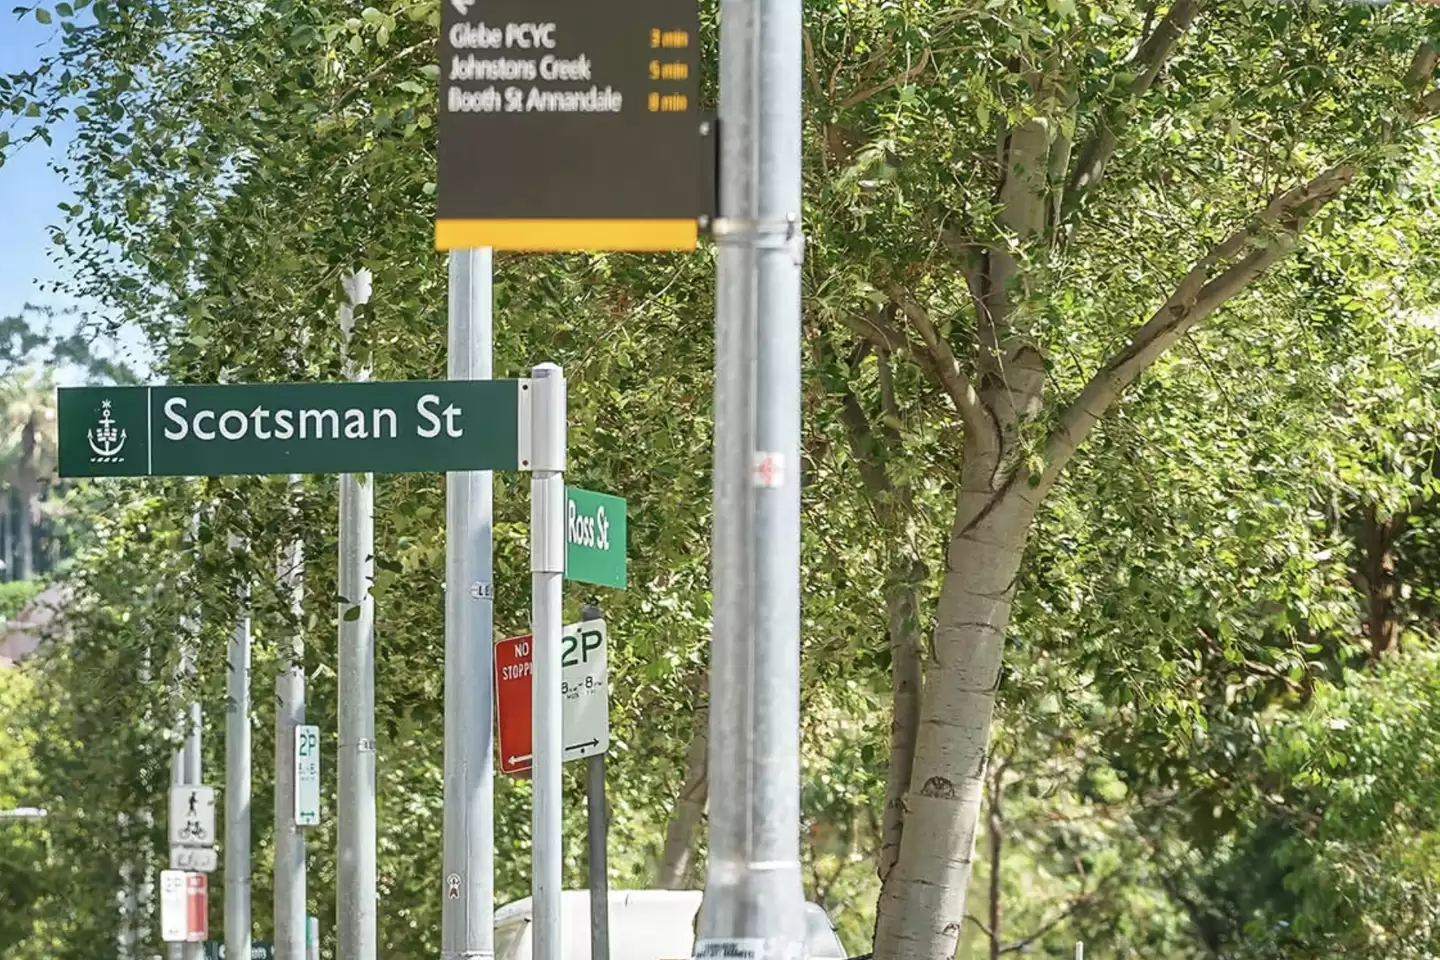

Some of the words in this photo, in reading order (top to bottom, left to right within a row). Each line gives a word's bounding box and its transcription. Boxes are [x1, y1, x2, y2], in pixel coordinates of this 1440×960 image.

[449, 22, 503, 49] Glebe
[505, 22, 557, 49] PCYC
[650, 28, 661, 48] 3
[661, 31, 689, 48] min
[449, 53, 537, 80] Johnstons
[539, 53, 592, 80] Creek
[661, 61, 689, 80] min
[448, 86, 502, 112] Booth
[504, 86, 523, 112] St
[526, 85, 623, 112] Annandale
[661, 93, 688, 112] min
[163, 396, 398, 440] Scotsman
[416, 394, 464, 438] St
[568, 499, 594, 547] Ross
[597, 506, 610, 551] St
[514, 642, 529, 658] NO
[562, 630, 602, 668] 2P
[502, 662, 533, 681] STOPP
[299, 733, 317, 756] 2P
